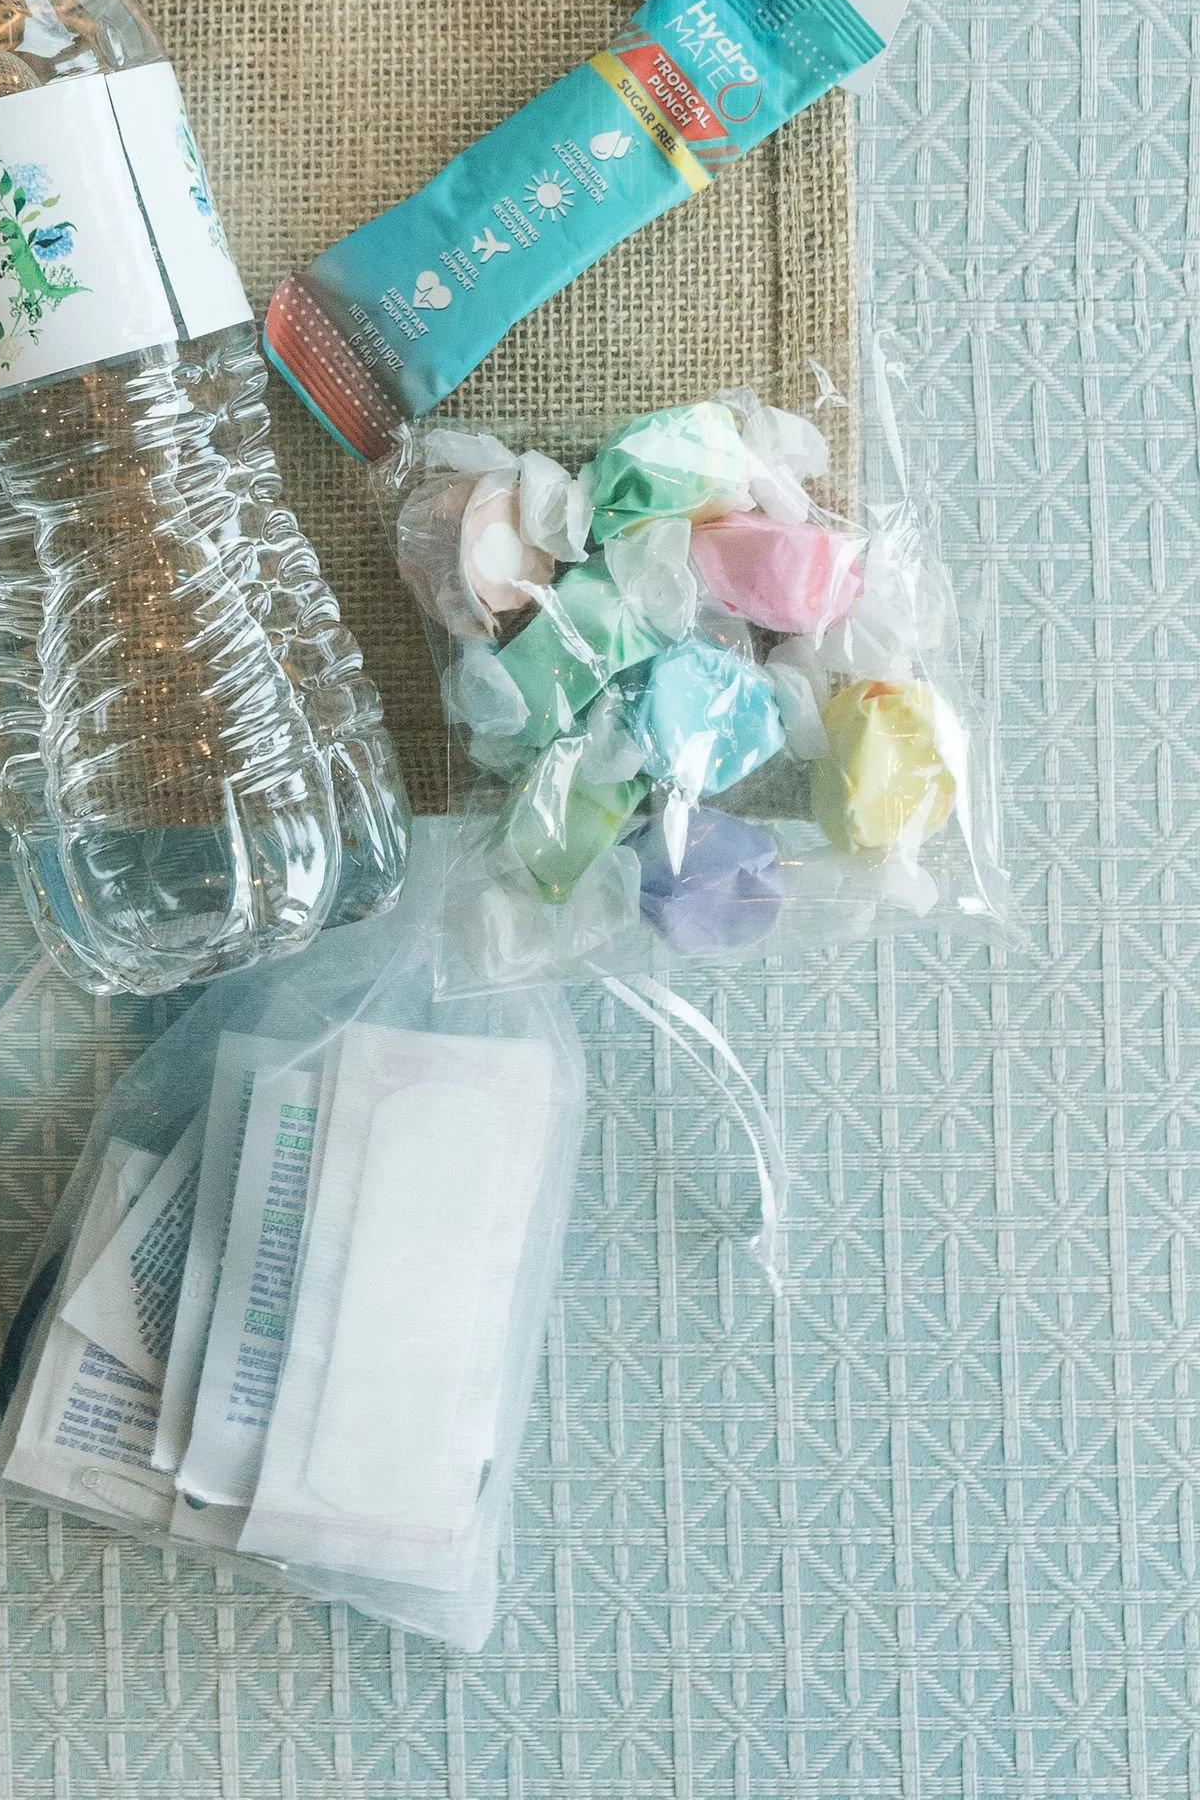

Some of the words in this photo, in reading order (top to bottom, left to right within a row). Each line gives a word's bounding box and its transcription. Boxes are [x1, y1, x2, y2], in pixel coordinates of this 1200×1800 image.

[664, 14, 735, 90] MATE
[617, 79, 656, 126] SUGAR
[651, 121, 681, 155] FREE
[647, 74, 691, 128] PUNCH
[651, 53, 712, 130] TROPICAL
[551, 143, 605, 205] ACCELERATOR
[563, 139, 609, 192] HYDRATION
[491, 204, 533, 250] RECOVERY
[501, 196, 541, 243] MORNING
[439, 251, 475, 293] SUPPORT
[451, 247, 481, 282] TRAVEL
[348, 304, 368, 326] NET
[363, 321, 380, 342] WT
[378, 296, 404, 325] YOUR
[399, 318, 419, 342] DAY
[386, 286, 431, 337] JUMPSTART
